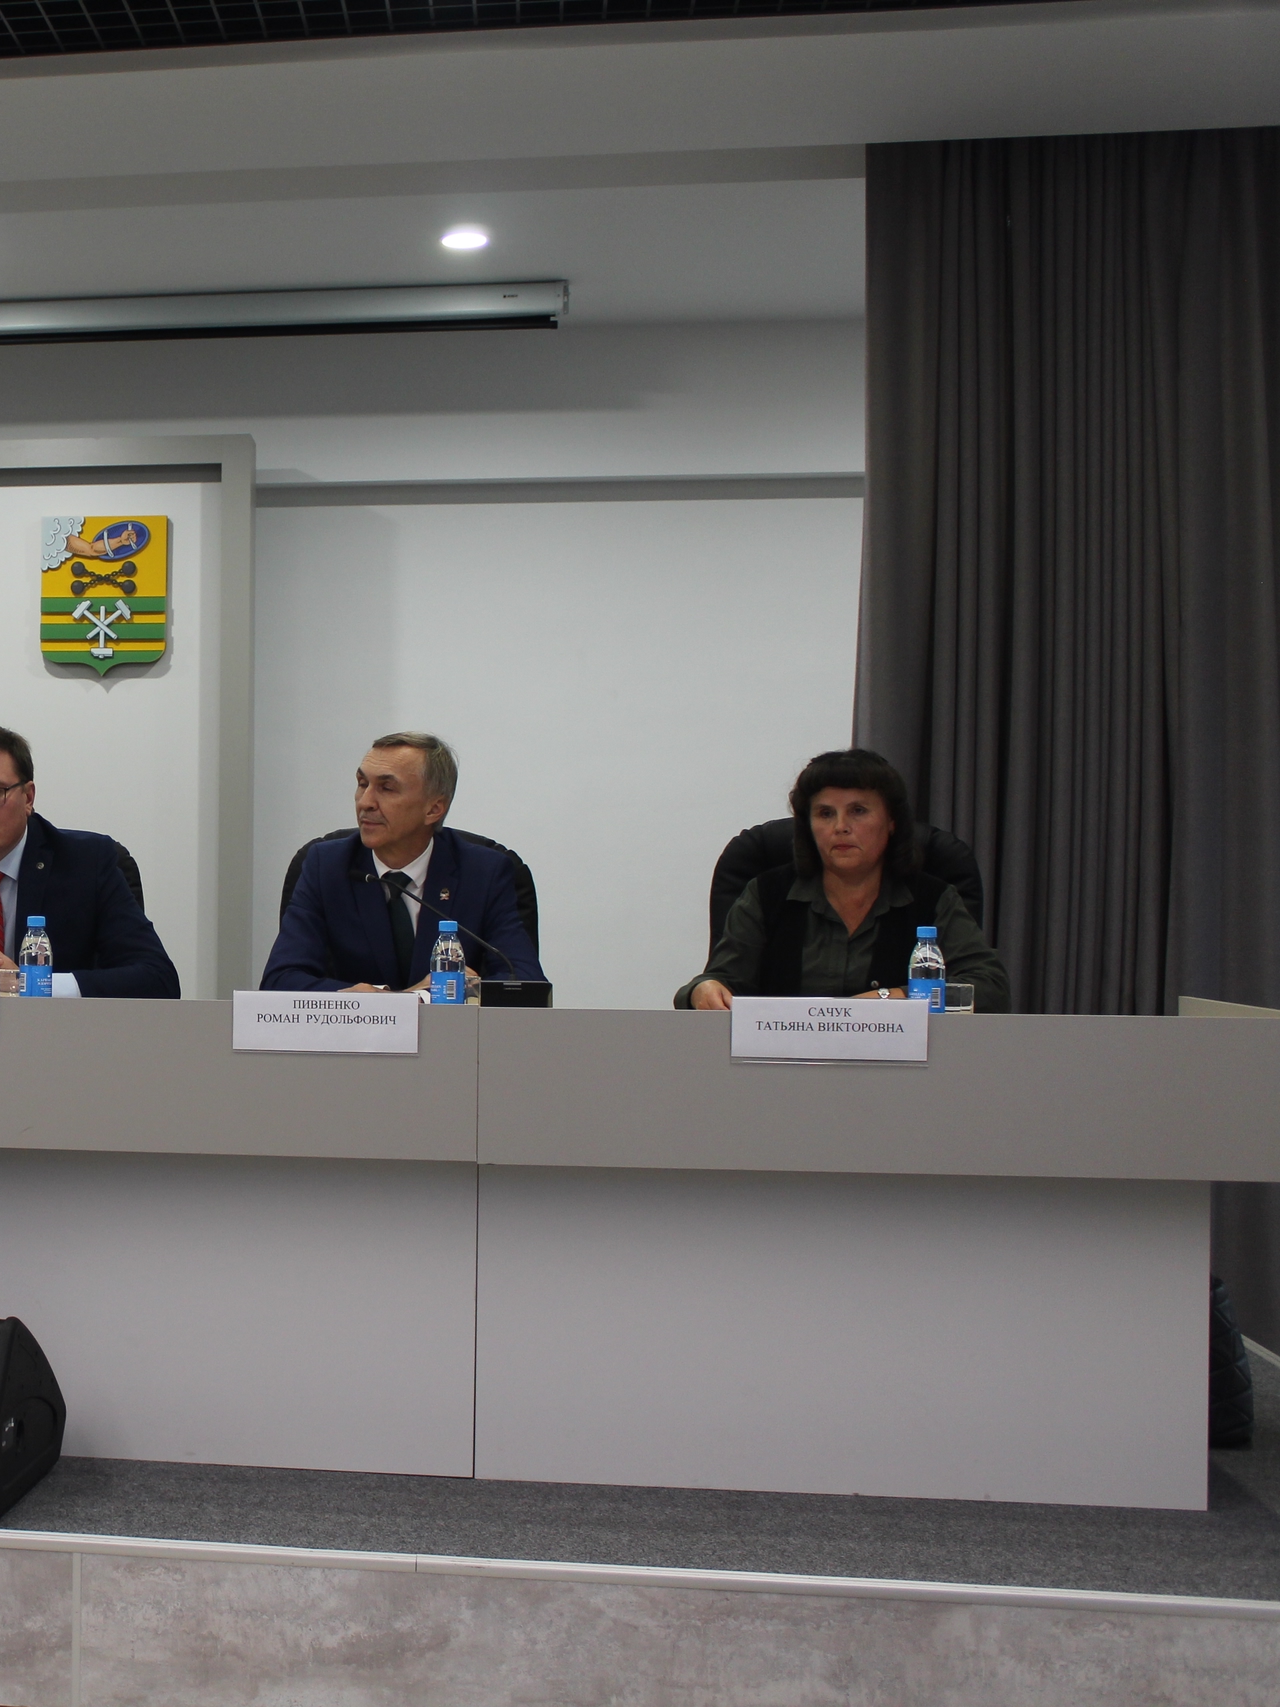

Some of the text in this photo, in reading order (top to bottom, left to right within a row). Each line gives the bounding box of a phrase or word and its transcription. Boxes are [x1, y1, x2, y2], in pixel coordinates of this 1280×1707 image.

[293, 999, 360, 1010] ПИВНЕНКО
[808, 1007, 852, 1018] САЧУК
[257, 1013, 396, 1025] РОМАН РУДОЛЬФОВИЧ
[756, 1021, 904, 1033] ТАТЬЯНА ВИКТОРОВНА
